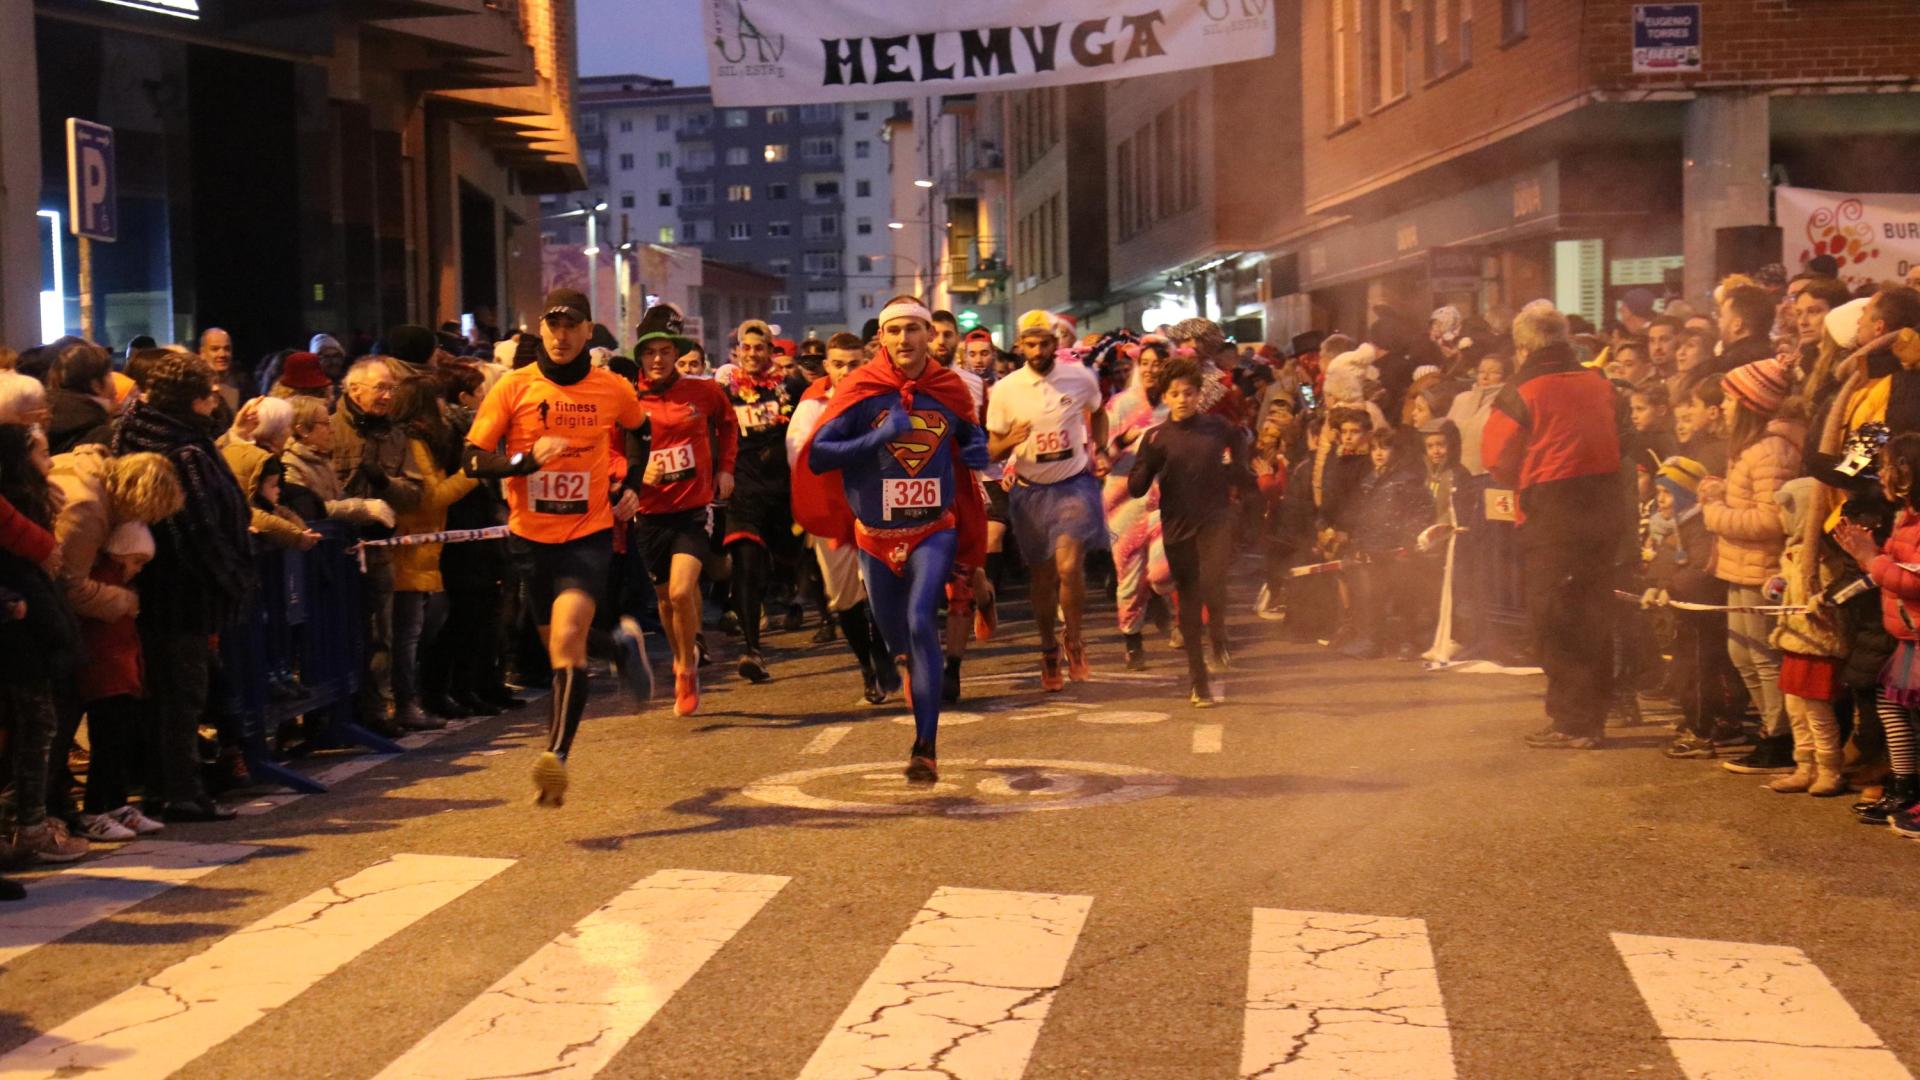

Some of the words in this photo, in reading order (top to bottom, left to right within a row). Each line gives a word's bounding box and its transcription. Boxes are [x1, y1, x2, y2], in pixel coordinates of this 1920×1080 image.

[1645, 16, 1692, 26] EUGENIO
[1647, 28, 1690, 38] TORRES
[82, 146, 107, 230] P
[555, 401, 598, 413] fitness
[555, 414, 598, 429] digital
[1036, 429, 1071, 452] 563
[539, 473, 586, 499] 162
[894, 480, 937, 506] 326
